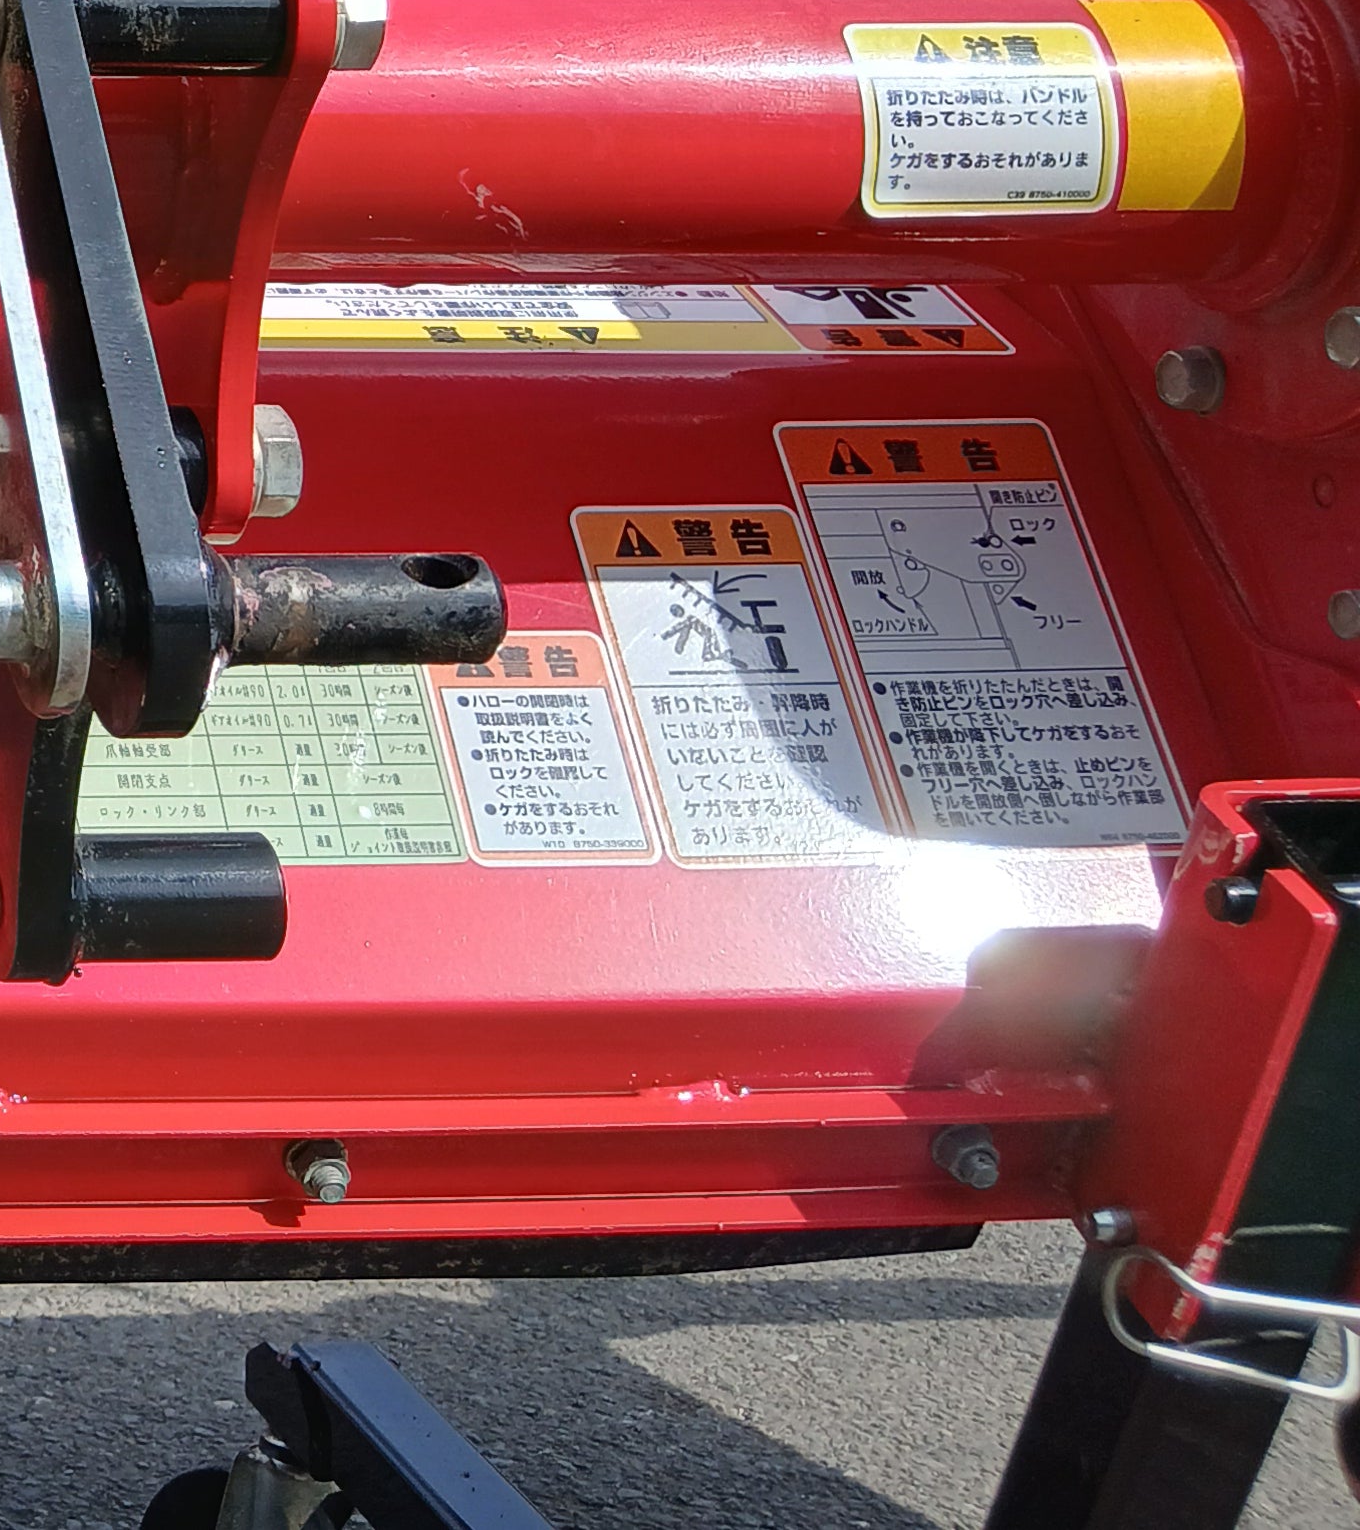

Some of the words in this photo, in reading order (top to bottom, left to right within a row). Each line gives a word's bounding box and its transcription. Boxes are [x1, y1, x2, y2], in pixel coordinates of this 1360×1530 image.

[890, 109, 1088, 128] を持っておこなってくださ
[890, 132, 916, 150] い。
[888, 152, 1088, 170] ケガをするおそれがありま
[887, 174, 912, 191] す。
[883, 437, 1000, 473] 警告
[1009, 516, 1057, 532] ロック
[671, 518, 773, 557] 警告
[850, 569, 886, 586] 開放
[851, 617, 930, 634] ロックハンドル
[1033, 614, 1082, 630] フリー
[472, 694, 590, 709] ハローの開閉時は
[475, 712, 593, 727] 取扱説明書をよく
[480, 729, 592, 744] 読んでください。
[485, 748, 590, 762] 折りたたみ時は
[489, 766, 608, 781] ロックを確認して
[495, 783, 561, 798] ください。
[498, 802, 619, 817] ケガをするおそれ
[503, 820, 586, 836] があります。
